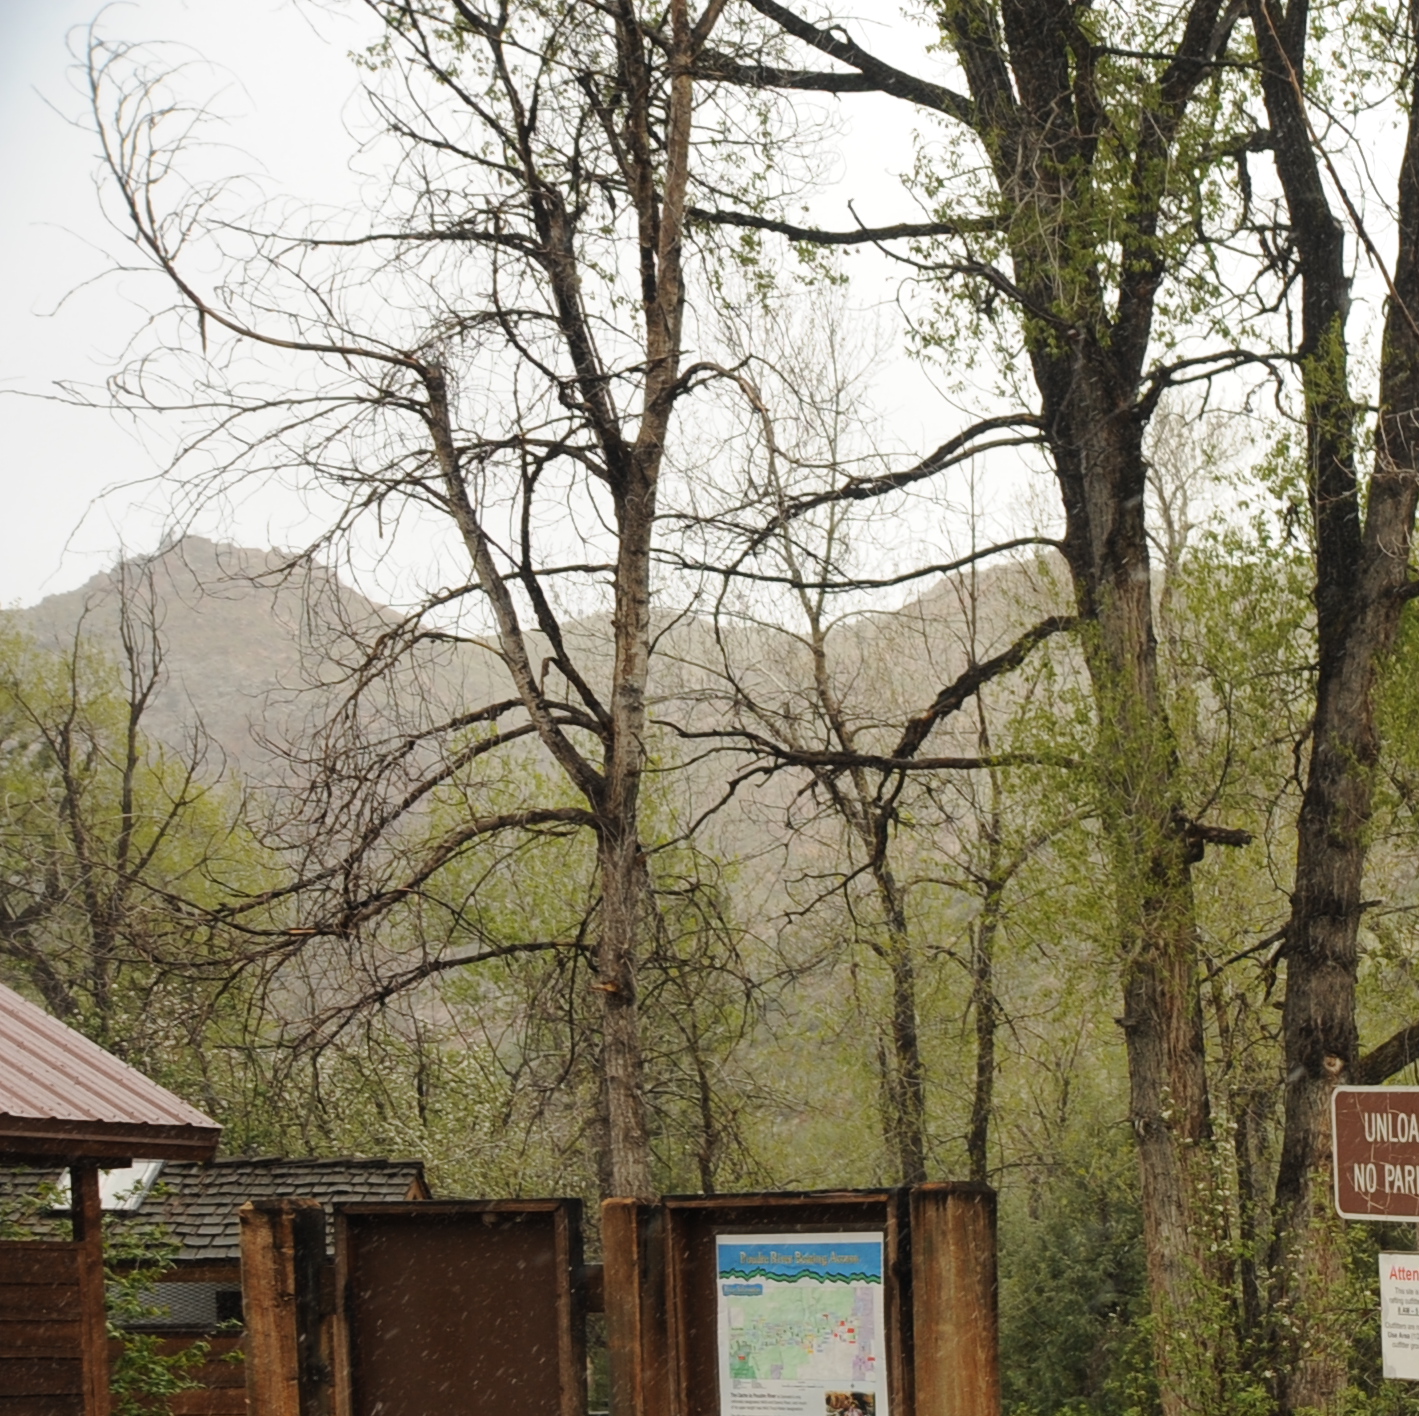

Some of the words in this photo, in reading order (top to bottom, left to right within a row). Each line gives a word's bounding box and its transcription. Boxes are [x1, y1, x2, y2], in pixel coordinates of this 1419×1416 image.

[1353, 1163, 1377, 1193] NO
[770, 1251, 793, 1264] River
[794, 1251, 829, 1266] Boating
[1395, 1287, 1405, 1295] This
